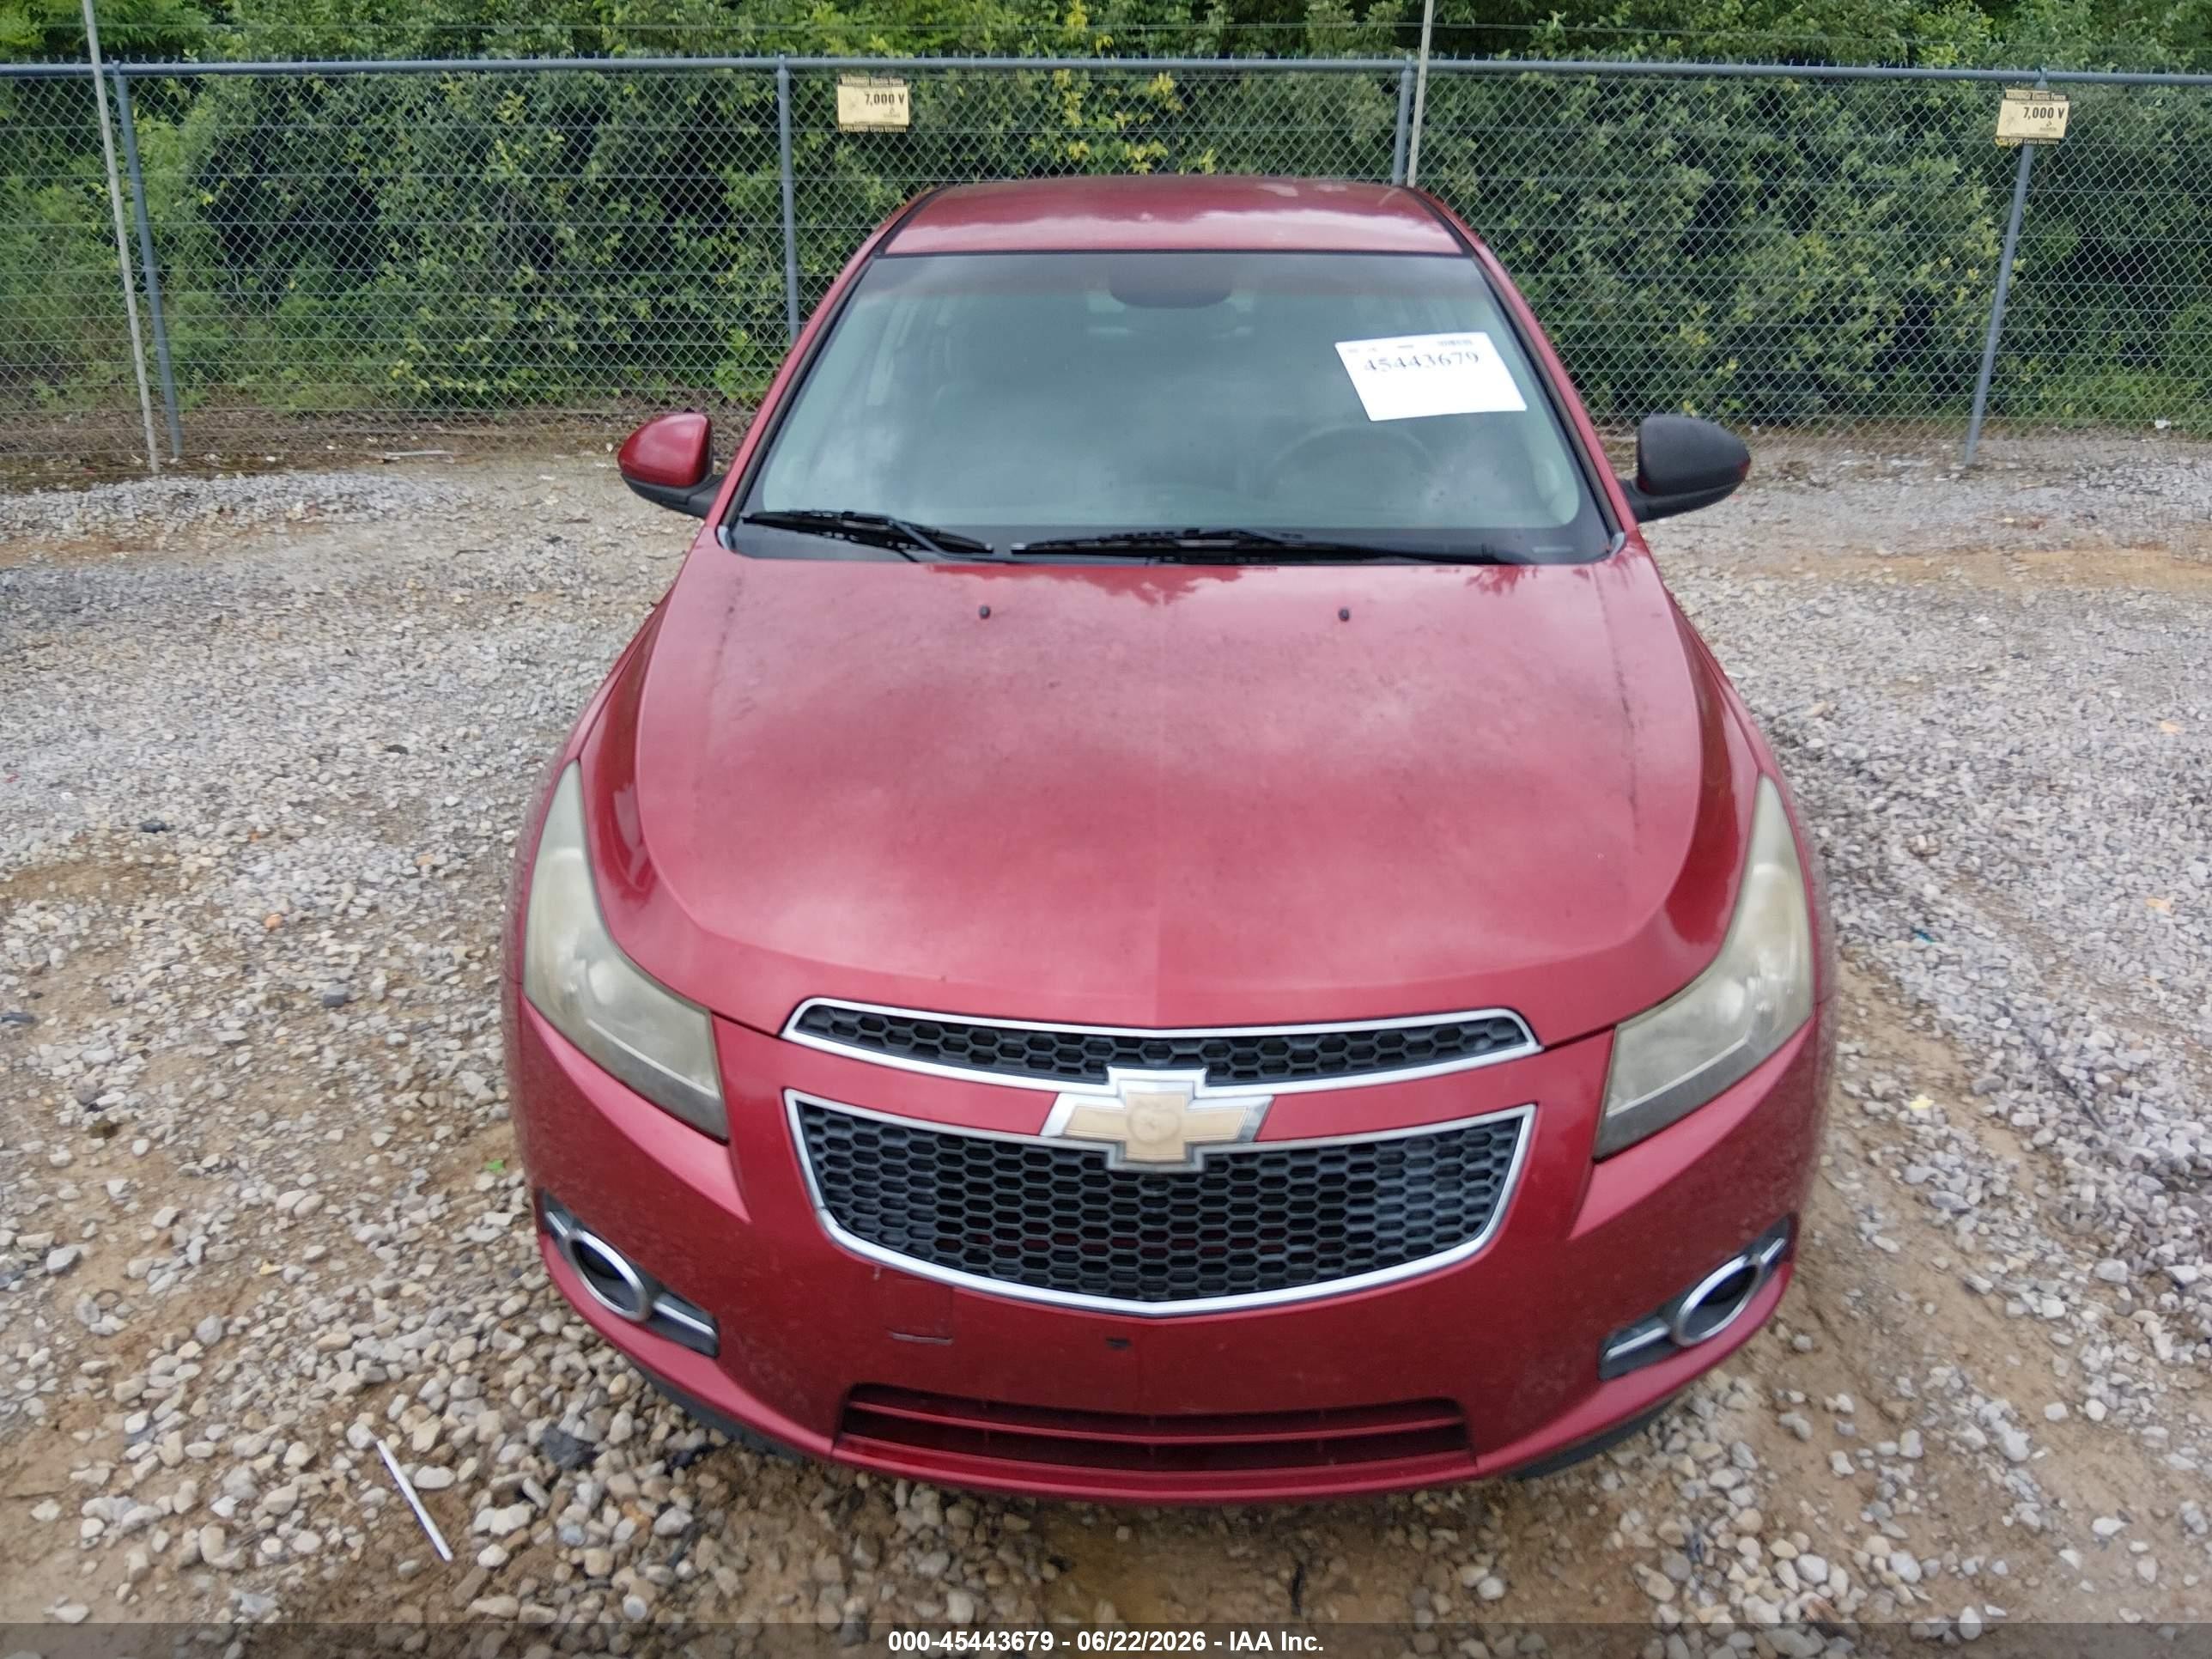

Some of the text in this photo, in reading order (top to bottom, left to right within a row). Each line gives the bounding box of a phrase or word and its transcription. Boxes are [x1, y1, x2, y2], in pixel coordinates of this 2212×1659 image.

[865, 94, 905, 106] 7,000 V
[2023, 106, 2065, 120] 7,000 V
[1364, 351, 1480, 373] 45443679
